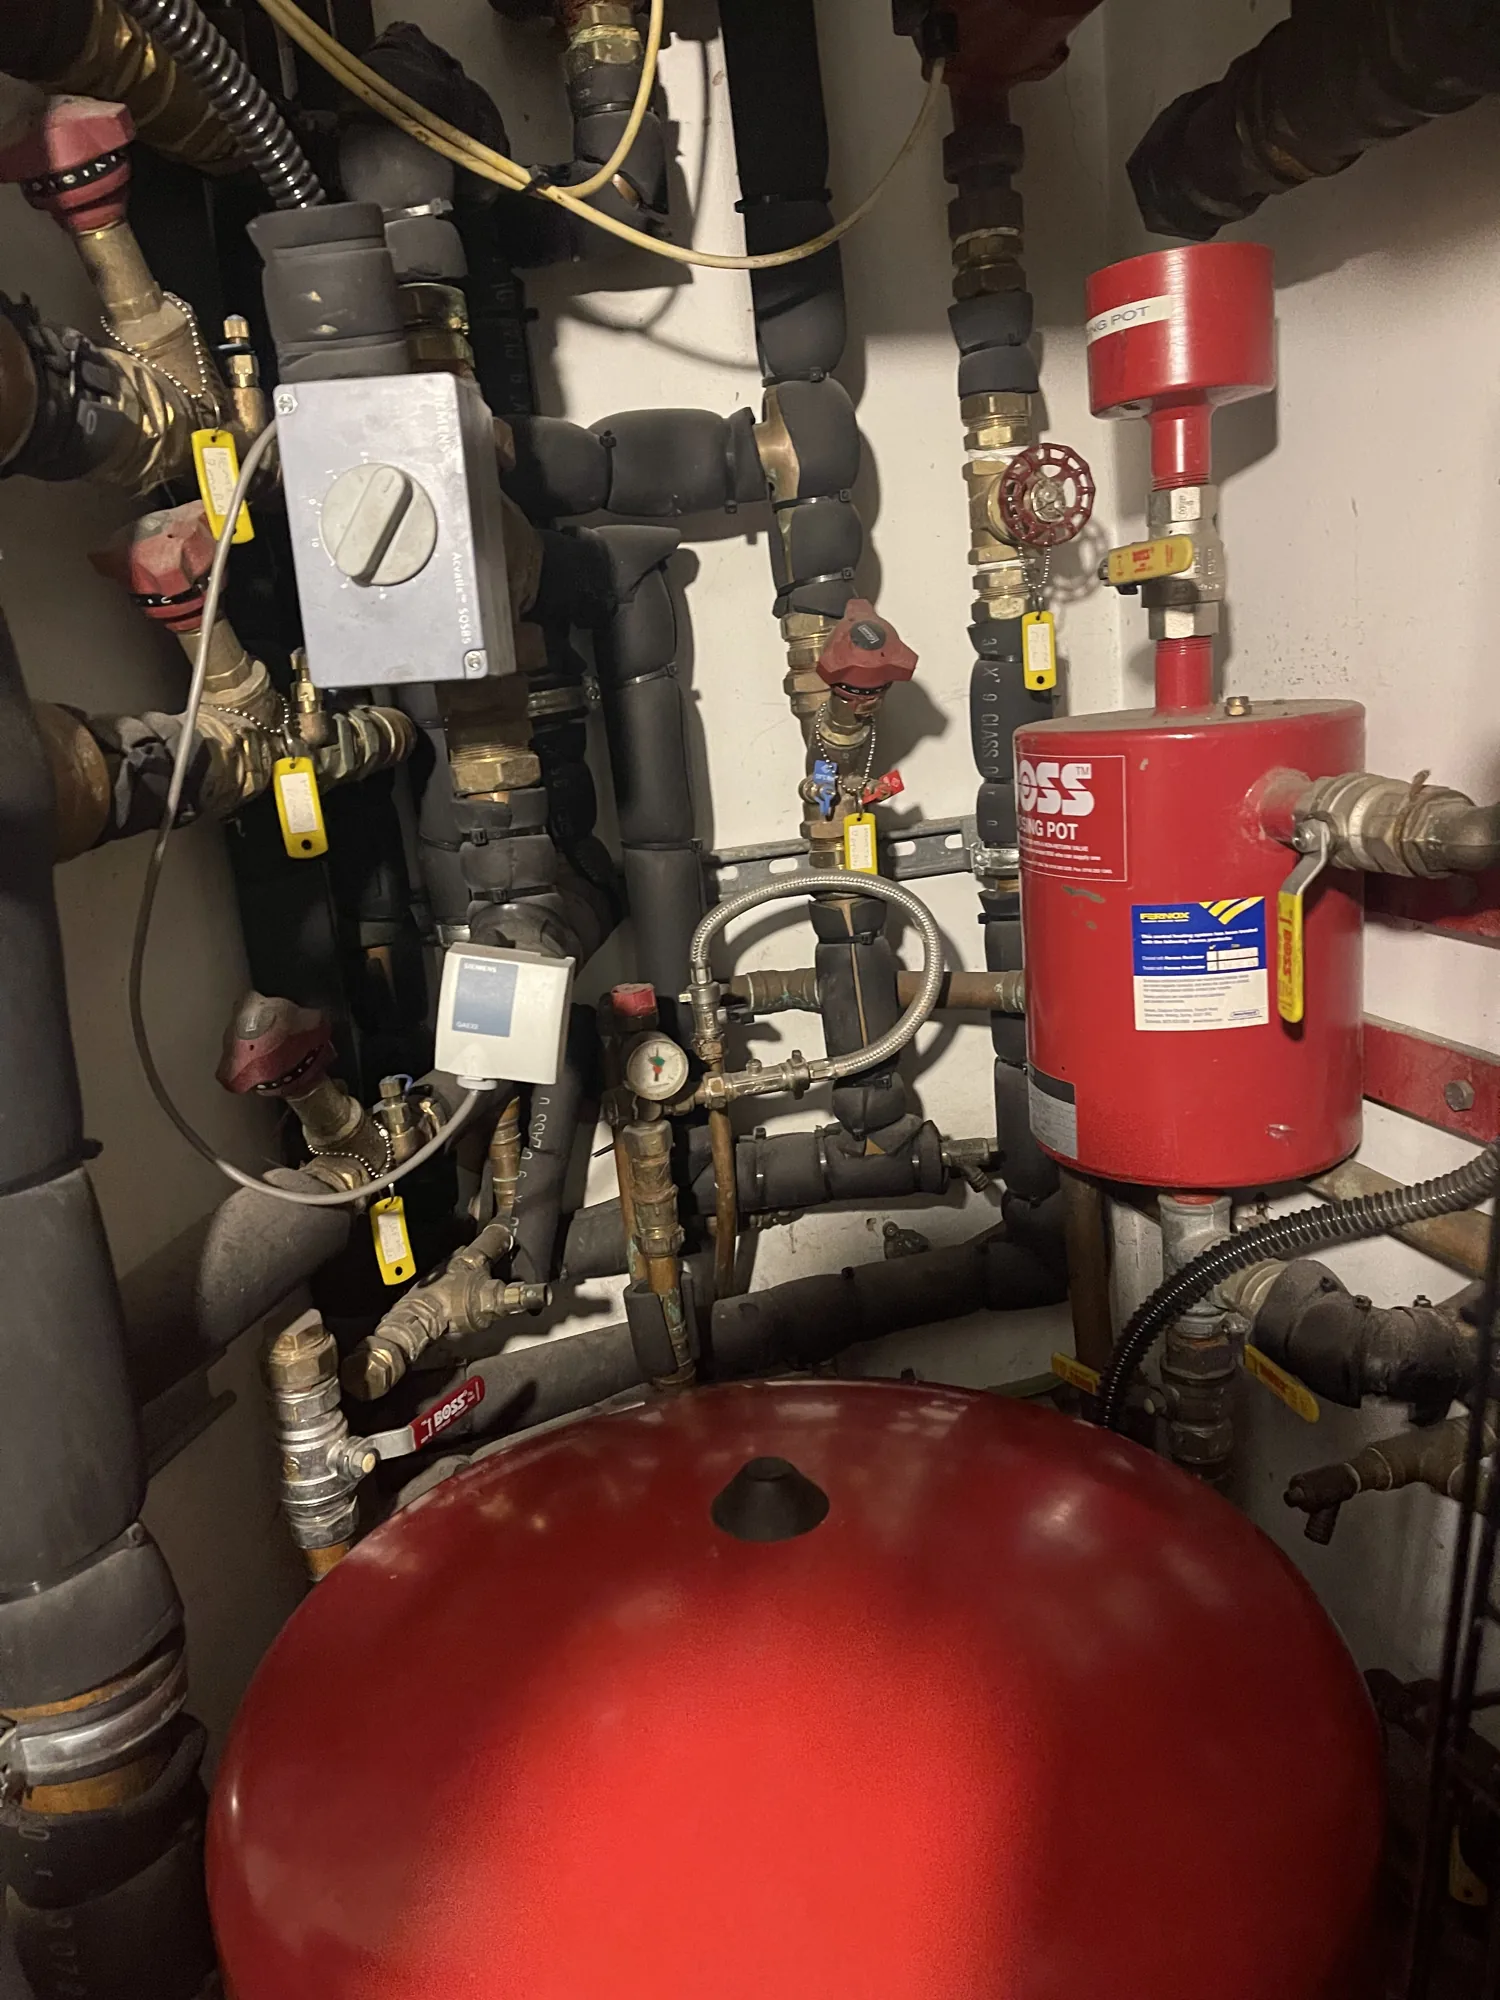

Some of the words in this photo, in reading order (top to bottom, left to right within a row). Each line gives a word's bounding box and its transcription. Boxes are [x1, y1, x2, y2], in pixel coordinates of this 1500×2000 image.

[1111, 305, 1150, 325] POT
[981, 713, 1000, 758] CLASS
[1046, 821, 1079, 840] POT
[1139, 912, 1190, 920] FERNOX
[463, 962, 497, 973] SIEMENS
[433, 1391, 466, 1428] BOSS
